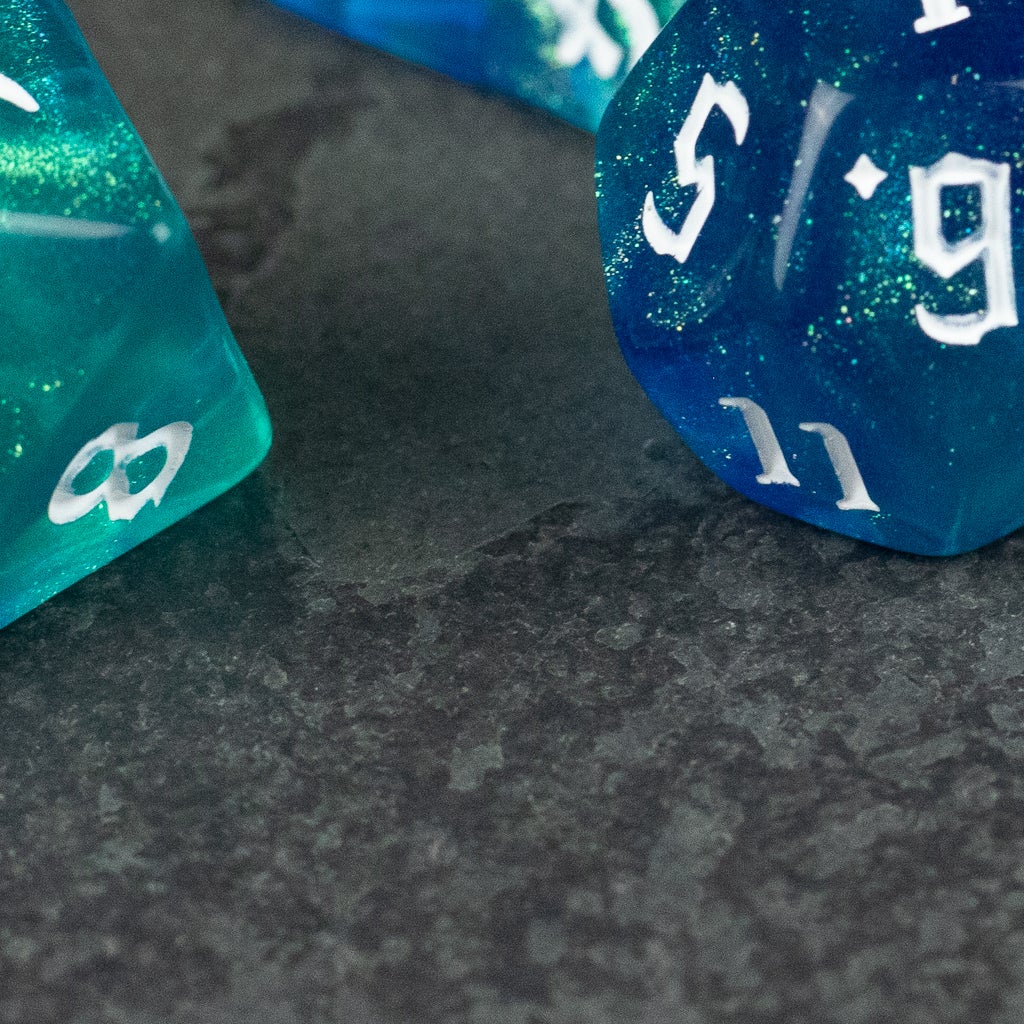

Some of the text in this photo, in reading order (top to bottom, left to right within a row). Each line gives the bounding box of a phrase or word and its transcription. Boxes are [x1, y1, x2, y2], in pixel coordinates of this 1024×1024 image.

[638, 73, 749, 263] 5
[48, 424, 192, 524] 8
[720, 399, 879, 511] 11
